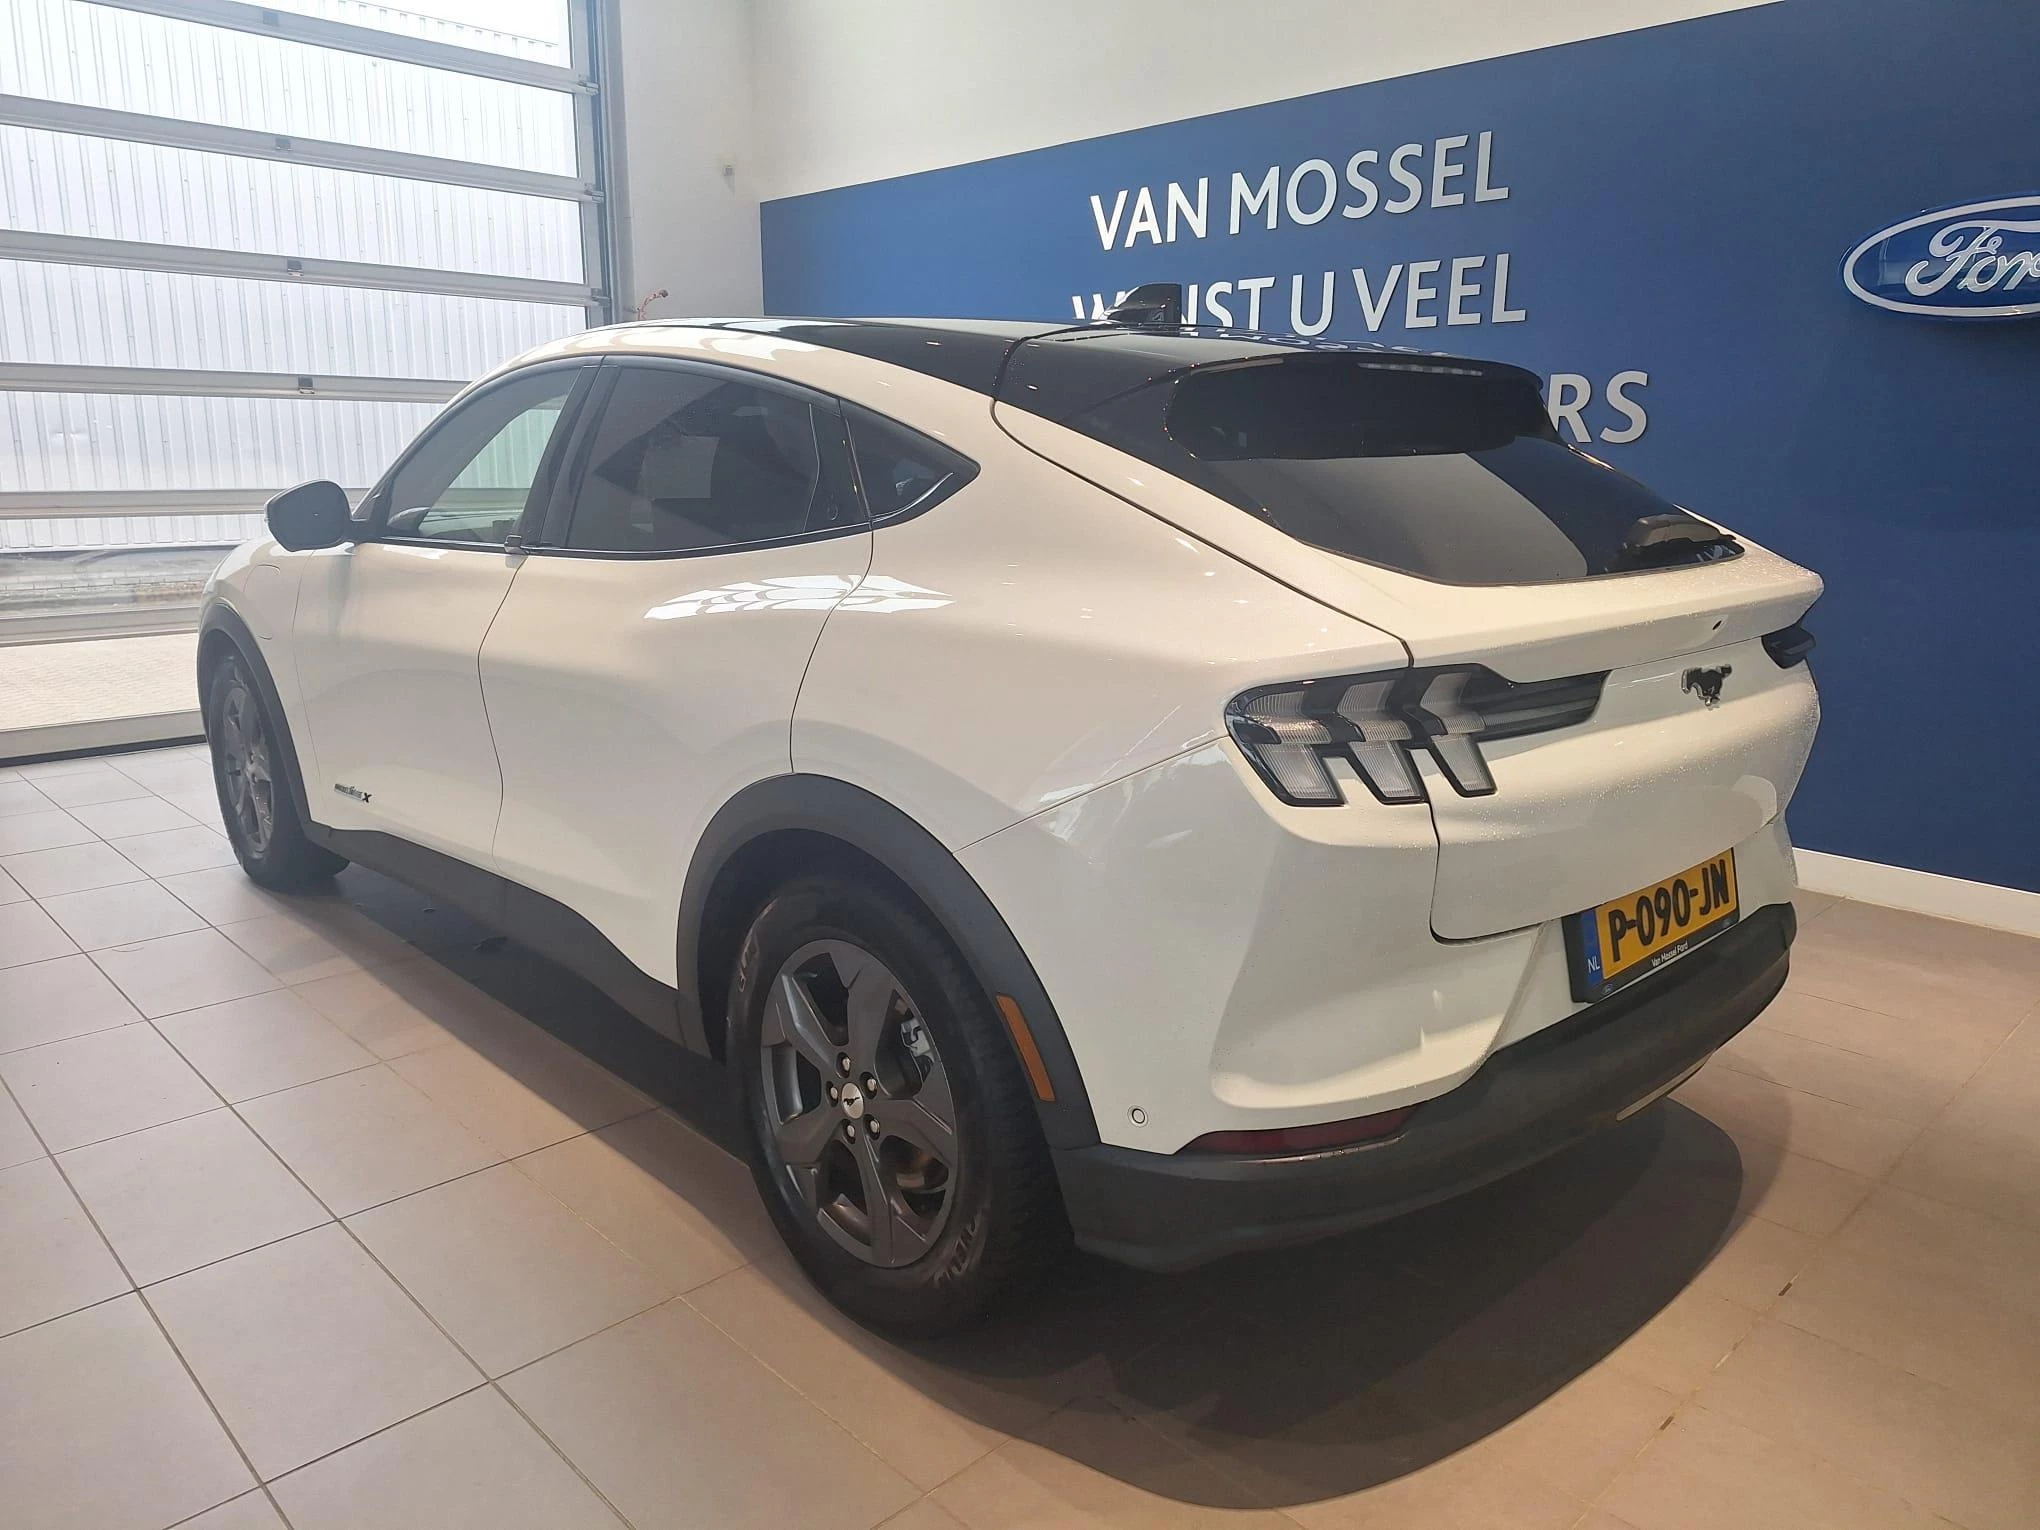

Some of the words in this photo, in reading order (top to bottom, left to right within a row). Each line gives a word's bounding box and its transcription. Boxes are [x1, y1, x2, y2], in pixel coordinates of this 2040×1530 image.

[1090, 177, 1208, 251] VAN
[1229, 130, 1510, 236] MOSSEL
[1290, 270, 1335, 337] U
[1351, 253, 1528, 333] VEEL
[1904, 219, 2040, 297] For
[1608, 858, 1730, 963] P-090-JN
[1676, 939, 1689, 954] Ford
[1587, 955, 1601, 974] NL
